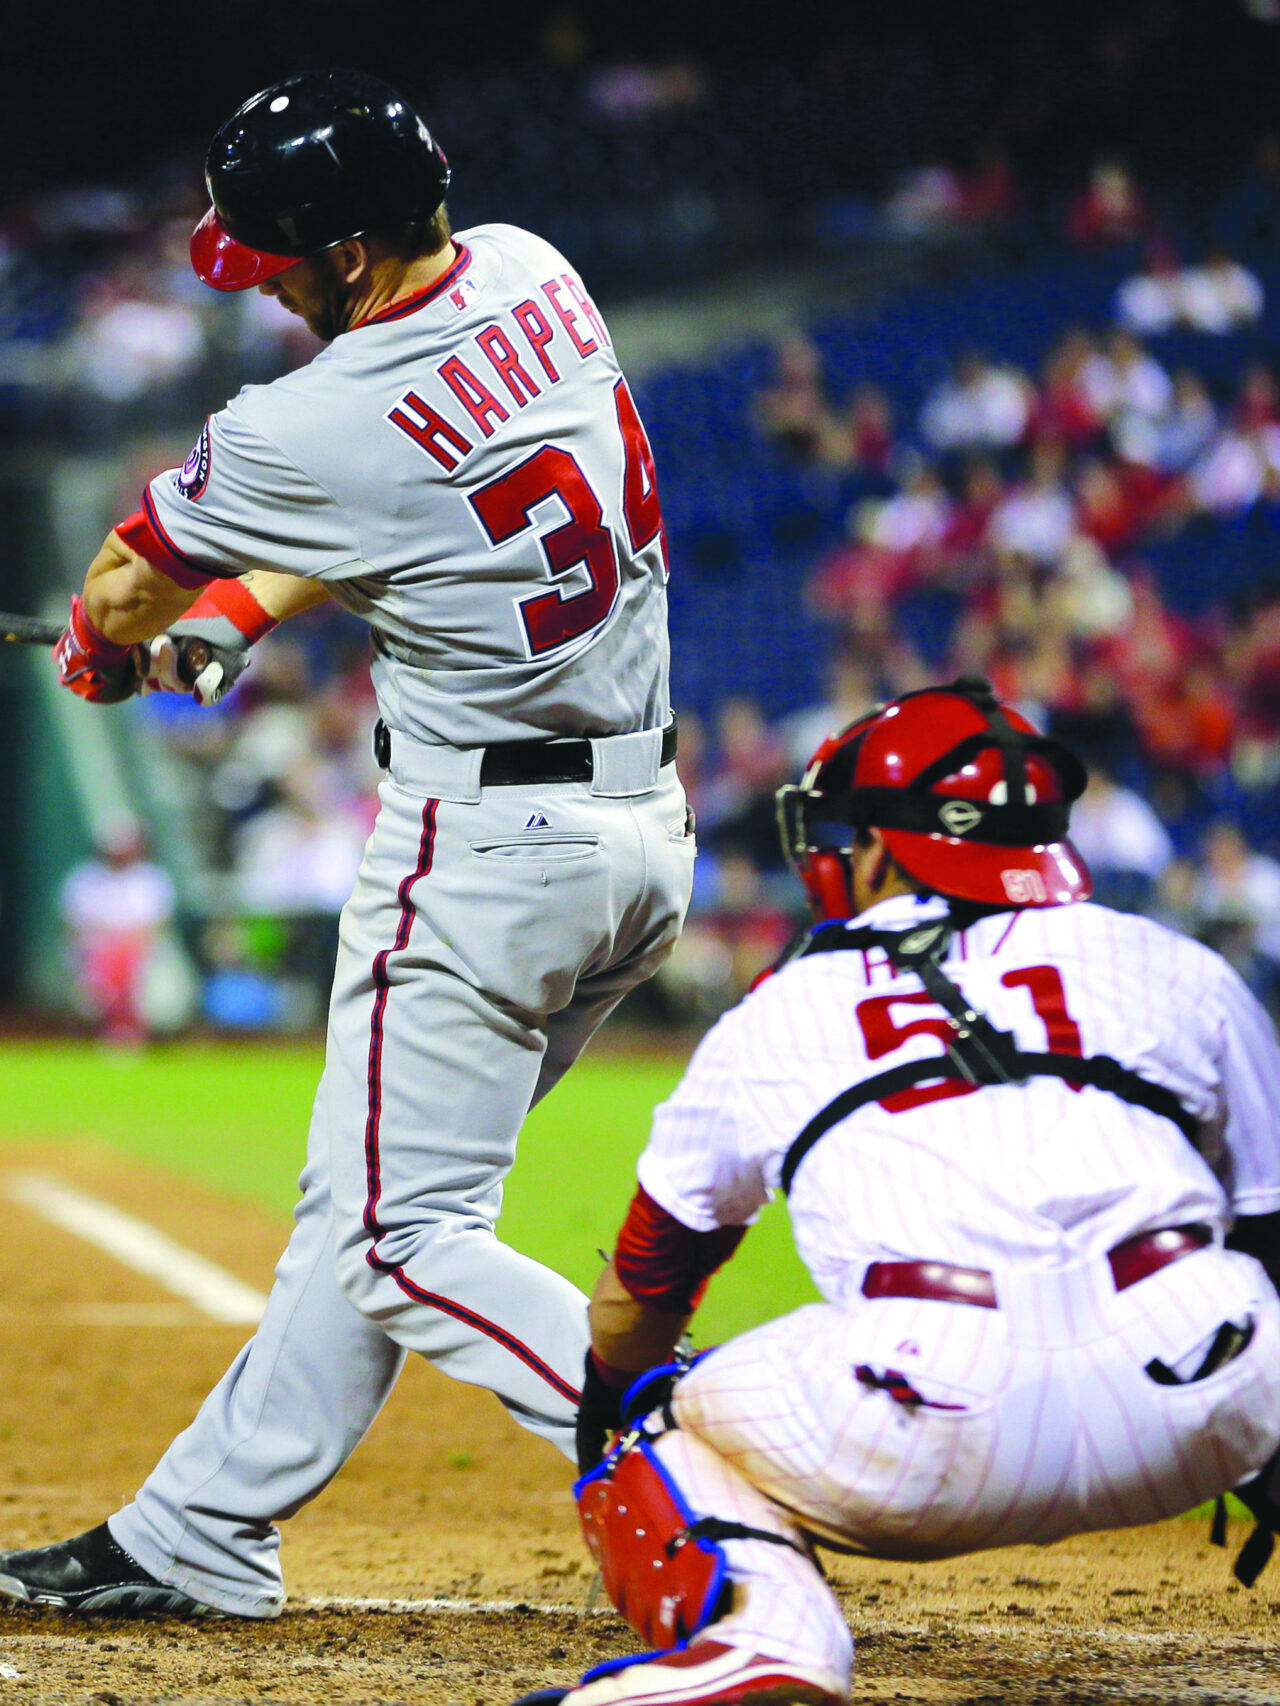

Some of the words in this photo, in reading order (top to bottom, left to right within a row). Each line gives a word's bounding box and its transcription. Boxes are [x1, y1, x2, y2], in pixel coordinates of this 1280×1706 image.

[382, 272, 611, 476] HARPER
[461, 370, 669, 663] 34
[855, 964, 1084, 1114] 51
